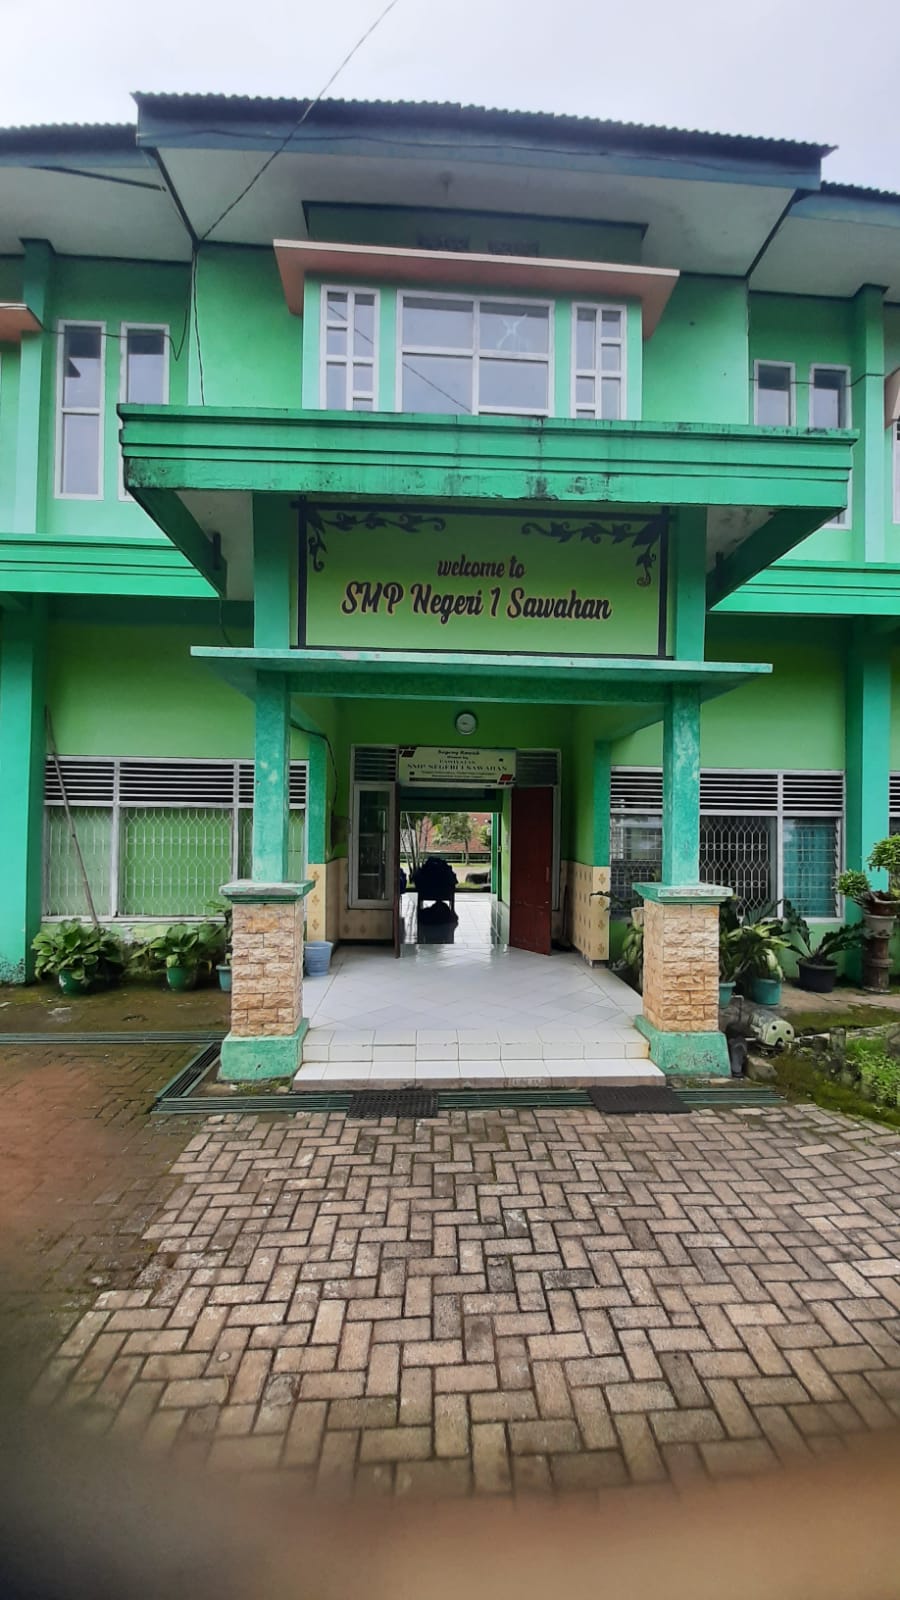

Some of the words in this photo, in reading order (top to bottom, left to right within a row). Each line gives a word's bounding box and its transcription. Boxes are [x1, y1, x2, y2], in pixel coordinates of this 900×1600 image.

[437, 554, 505, 578] welcome
[508, 555, 526, 579] to
[341, 581, 404, 615] SMP
[409, 583, 484, 625] Negeri
[489, 587, 501, 617] 1
[506, 586, 613, 620] Sawahan
